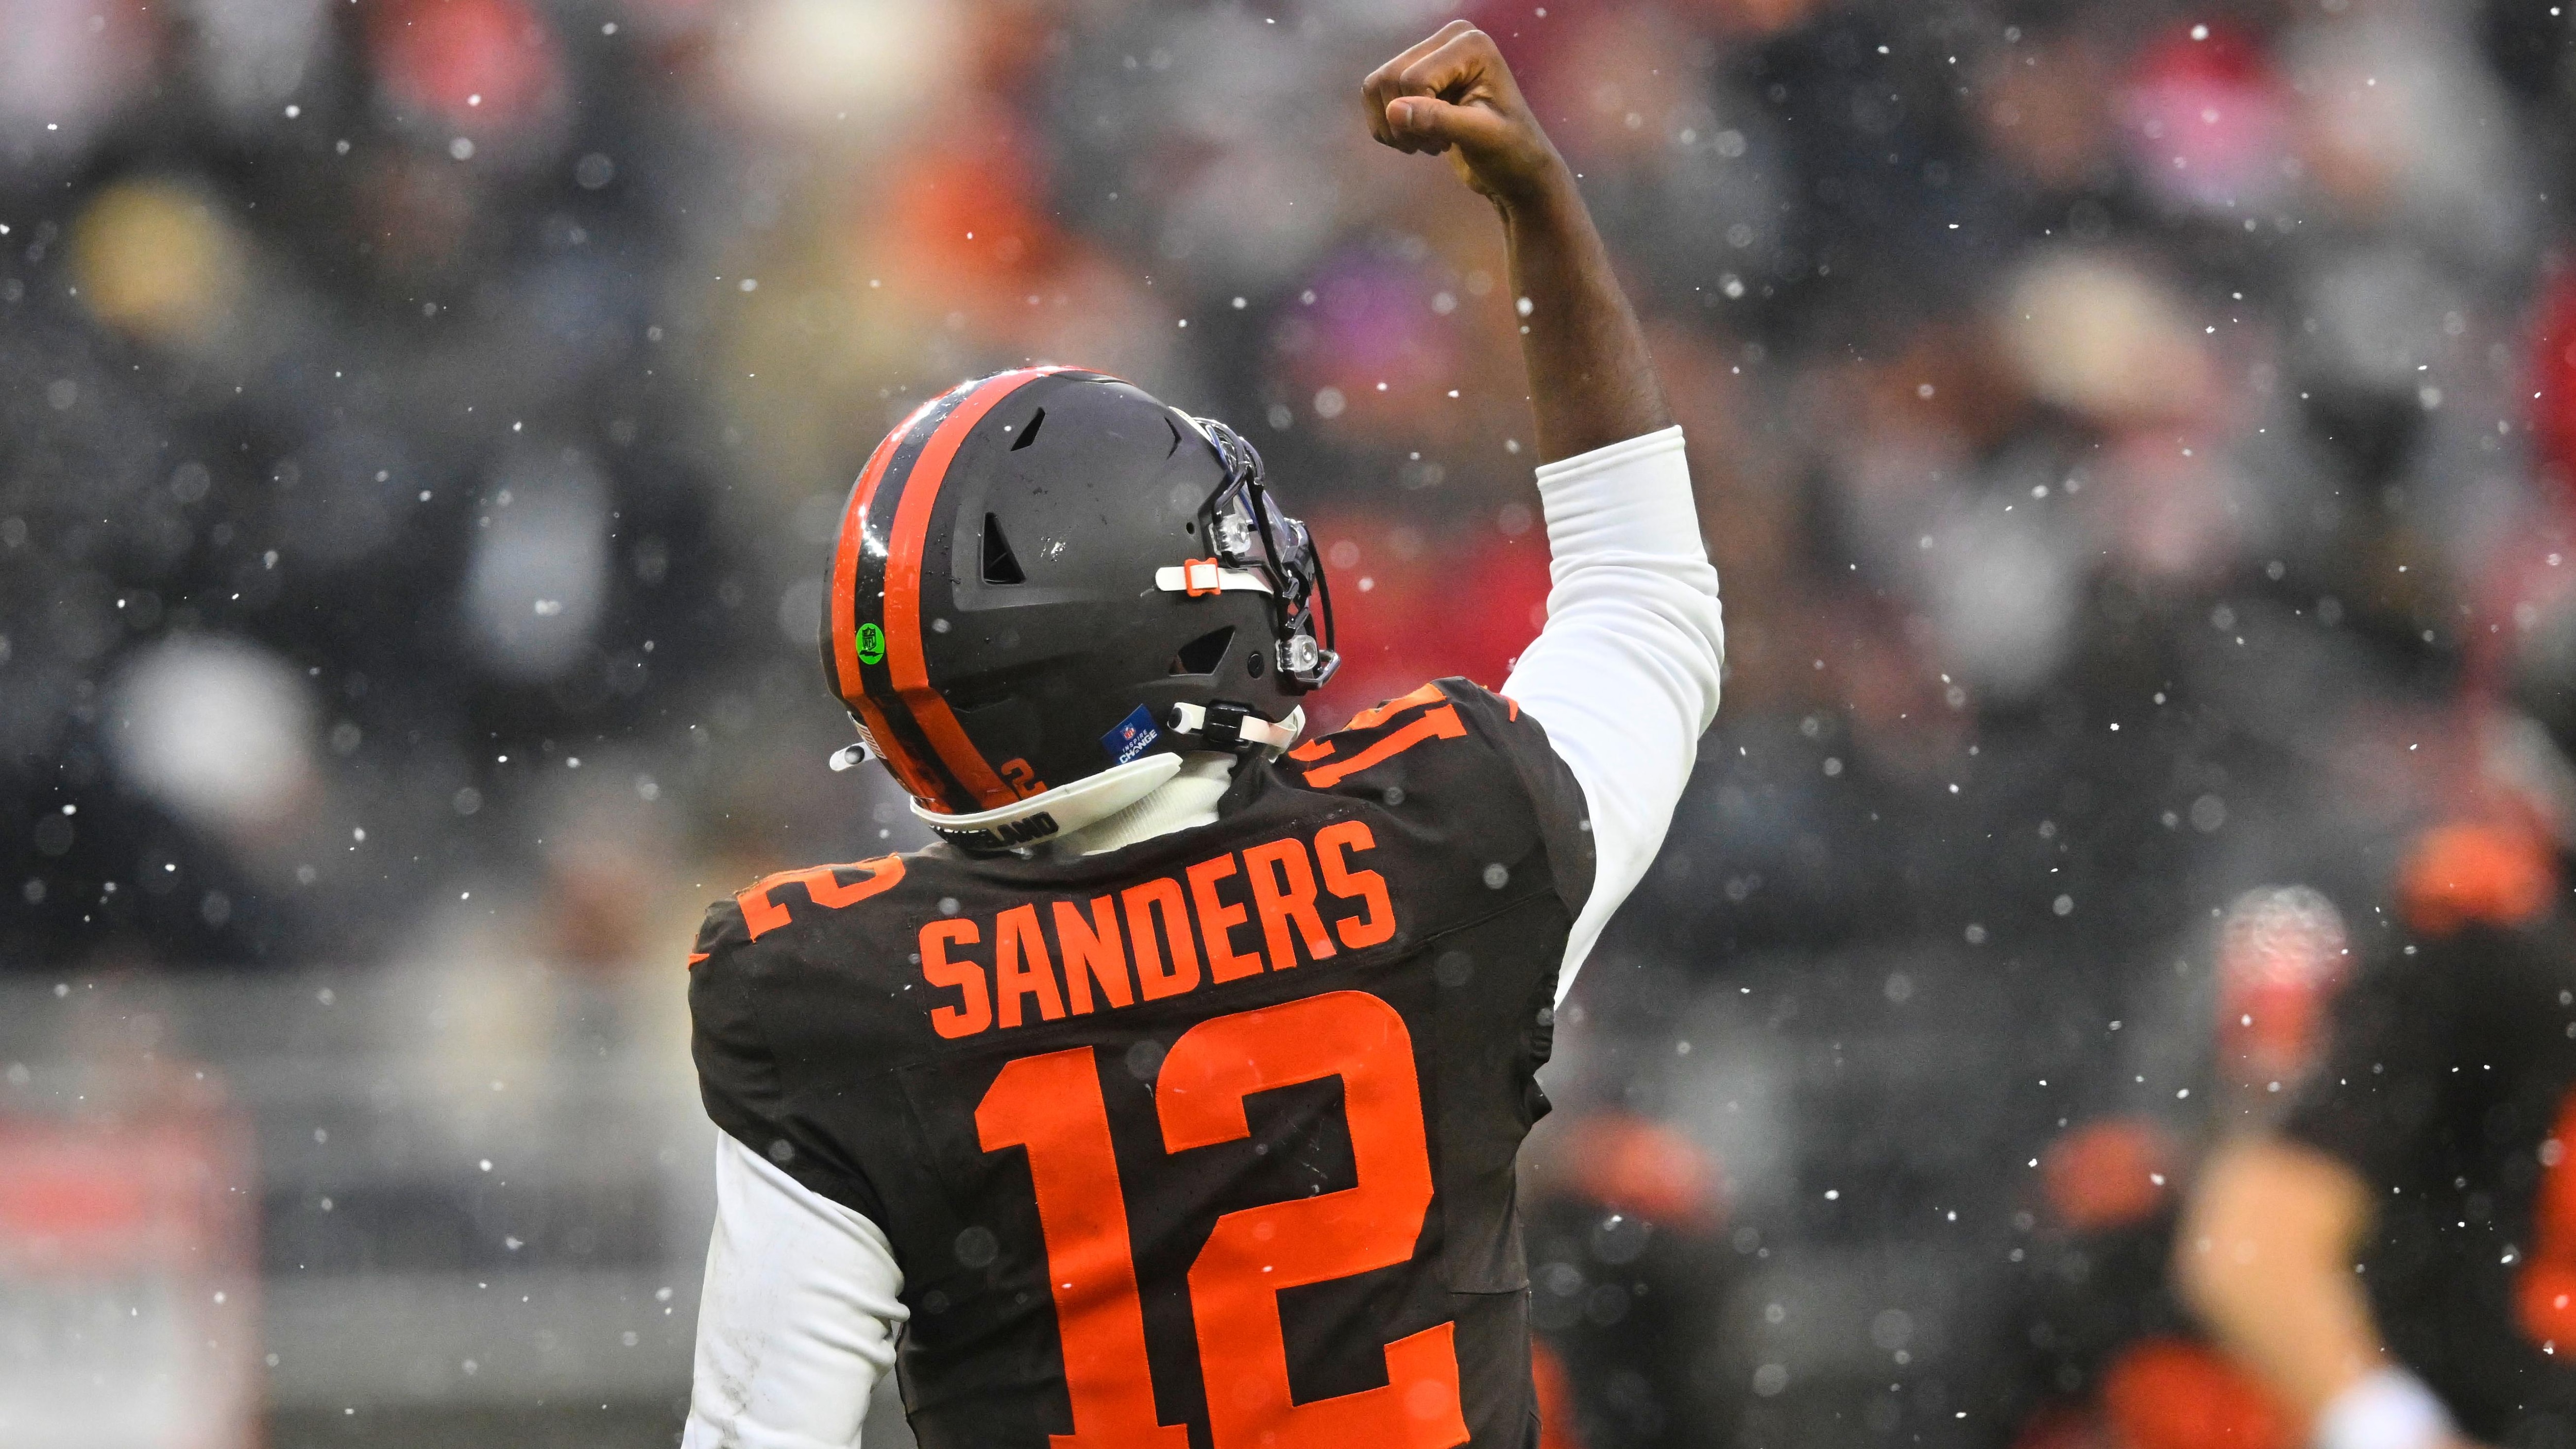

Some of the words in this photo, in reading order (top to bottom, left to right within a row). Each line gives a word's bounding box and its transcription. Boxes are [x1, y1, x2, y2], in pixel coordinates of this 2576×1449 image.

[1119, 729, 1158, 764] CHANGE
[1122, 729, 1148, 753] INSPIRE
[1001, 757, 1048, 801] 2
[919, 820, 1396, 1039] SANDERS
[974, 990, 1470, 1449] 12
